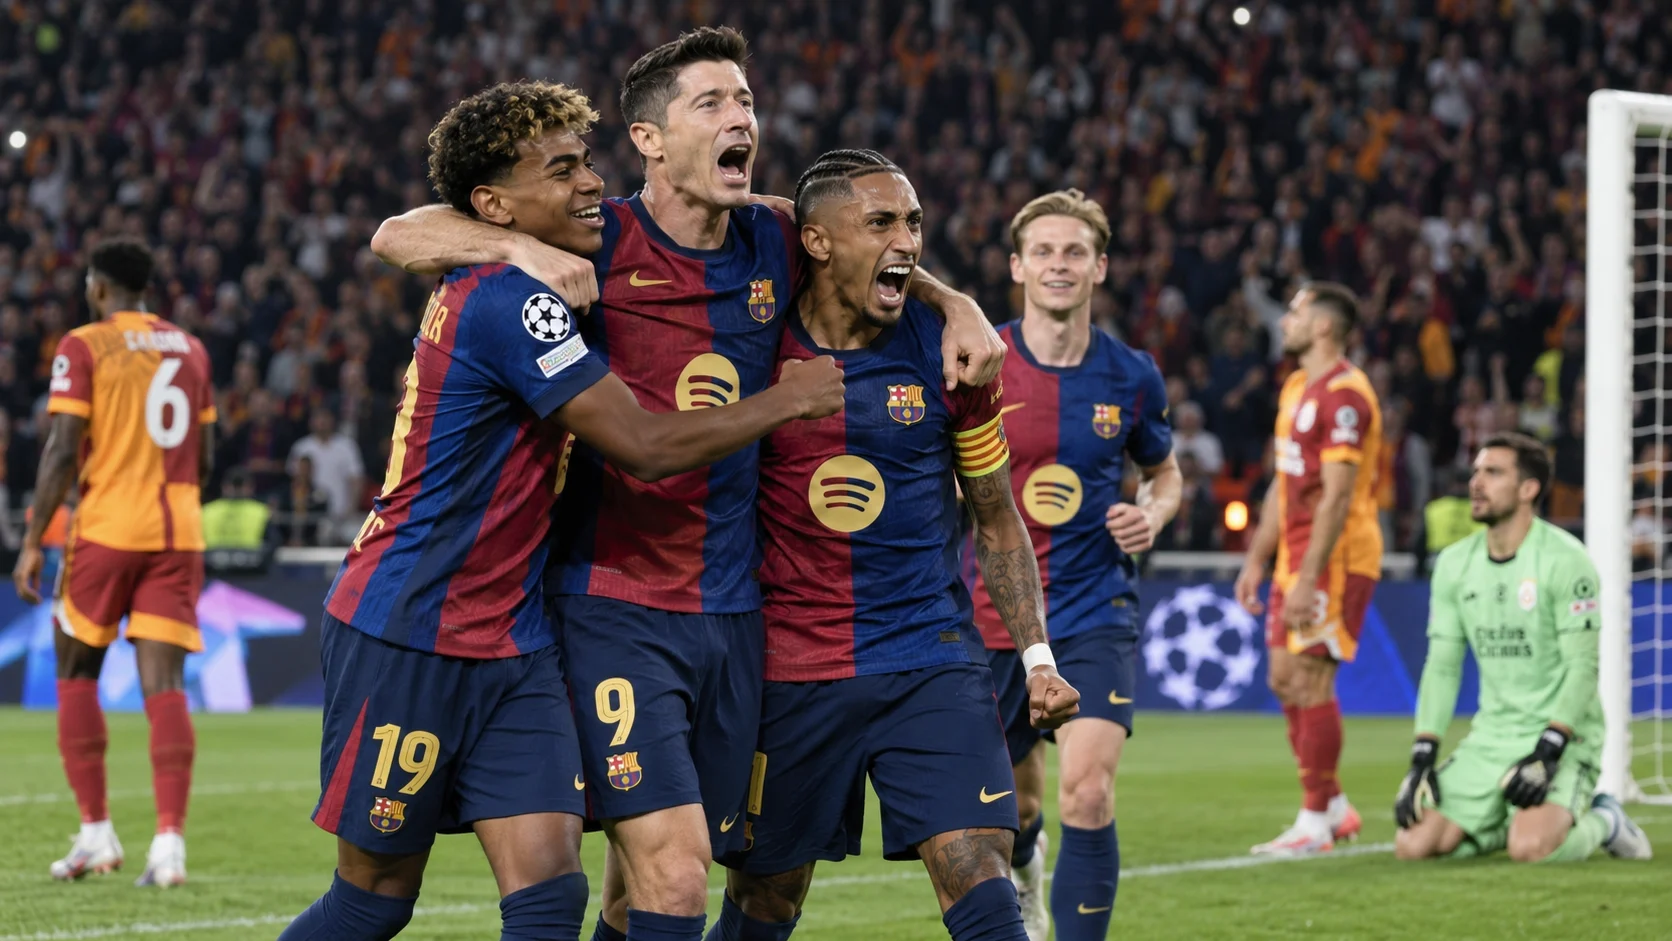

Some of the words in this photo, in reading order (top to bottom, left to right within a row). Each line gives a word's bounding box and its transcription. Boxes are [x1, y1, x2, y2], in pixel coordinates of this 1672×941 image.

[145, 357, 190, 449] 6
[595, 677, 635, 747] 9
[370, 723, 441, 795] 19
